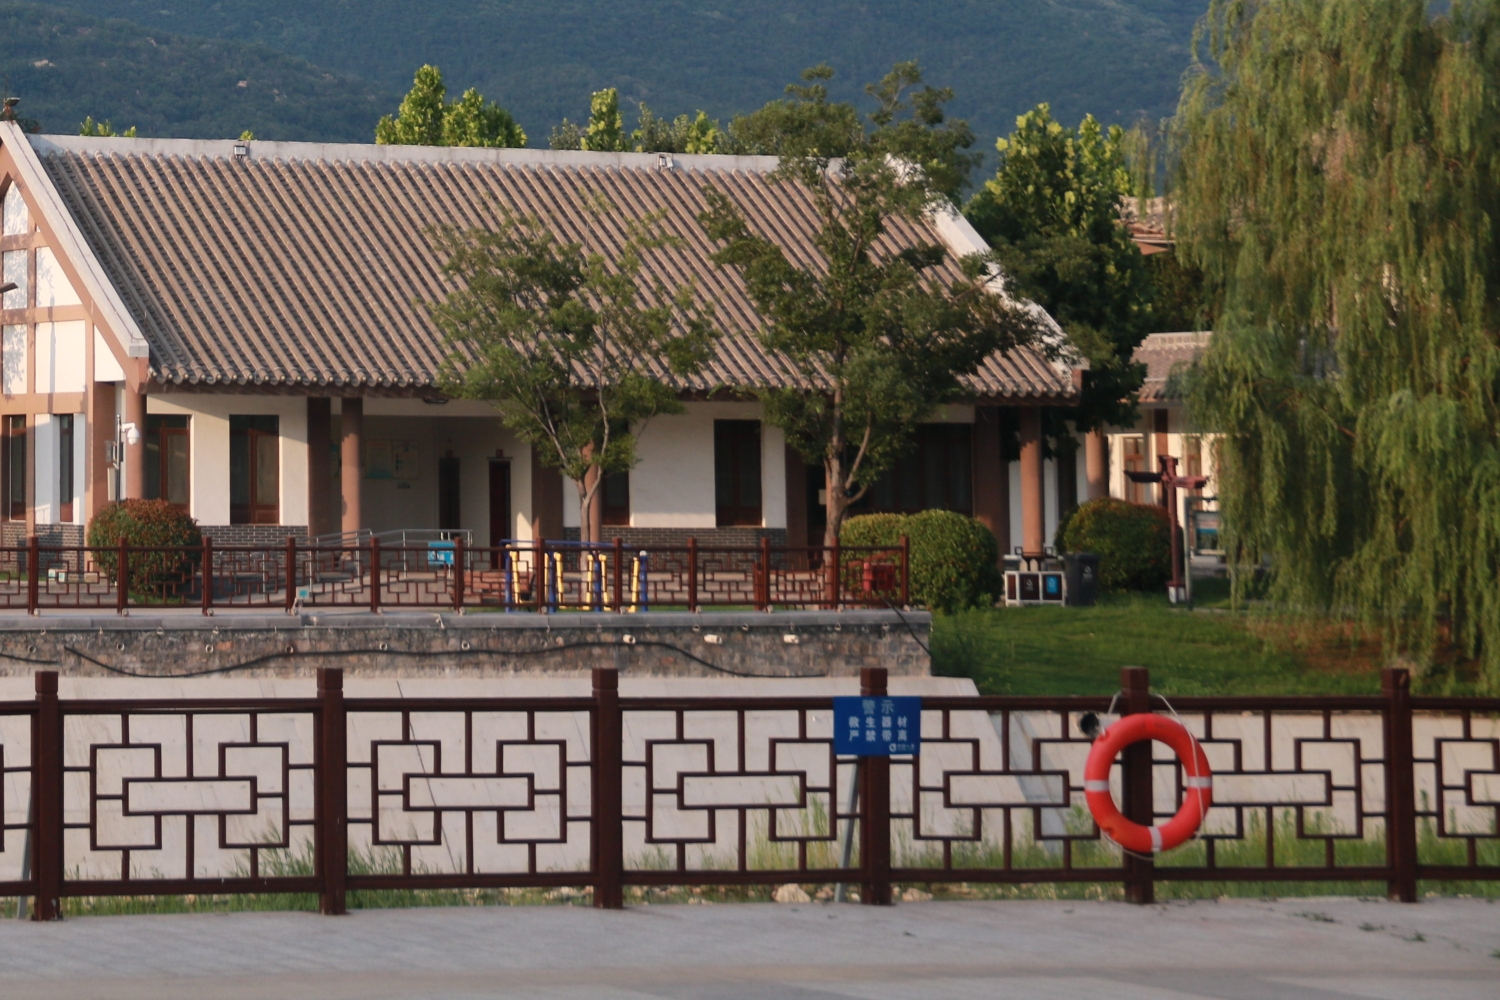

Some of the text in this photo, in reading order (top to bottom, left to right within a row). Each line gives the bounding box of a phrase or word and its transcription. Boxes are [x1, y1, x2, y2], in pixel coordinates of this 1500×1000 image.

[862, 699, 894, 714] 警示
[848, 716, 907, 728] 救生器材
[848, 730, 907, 742] 严禁带离
